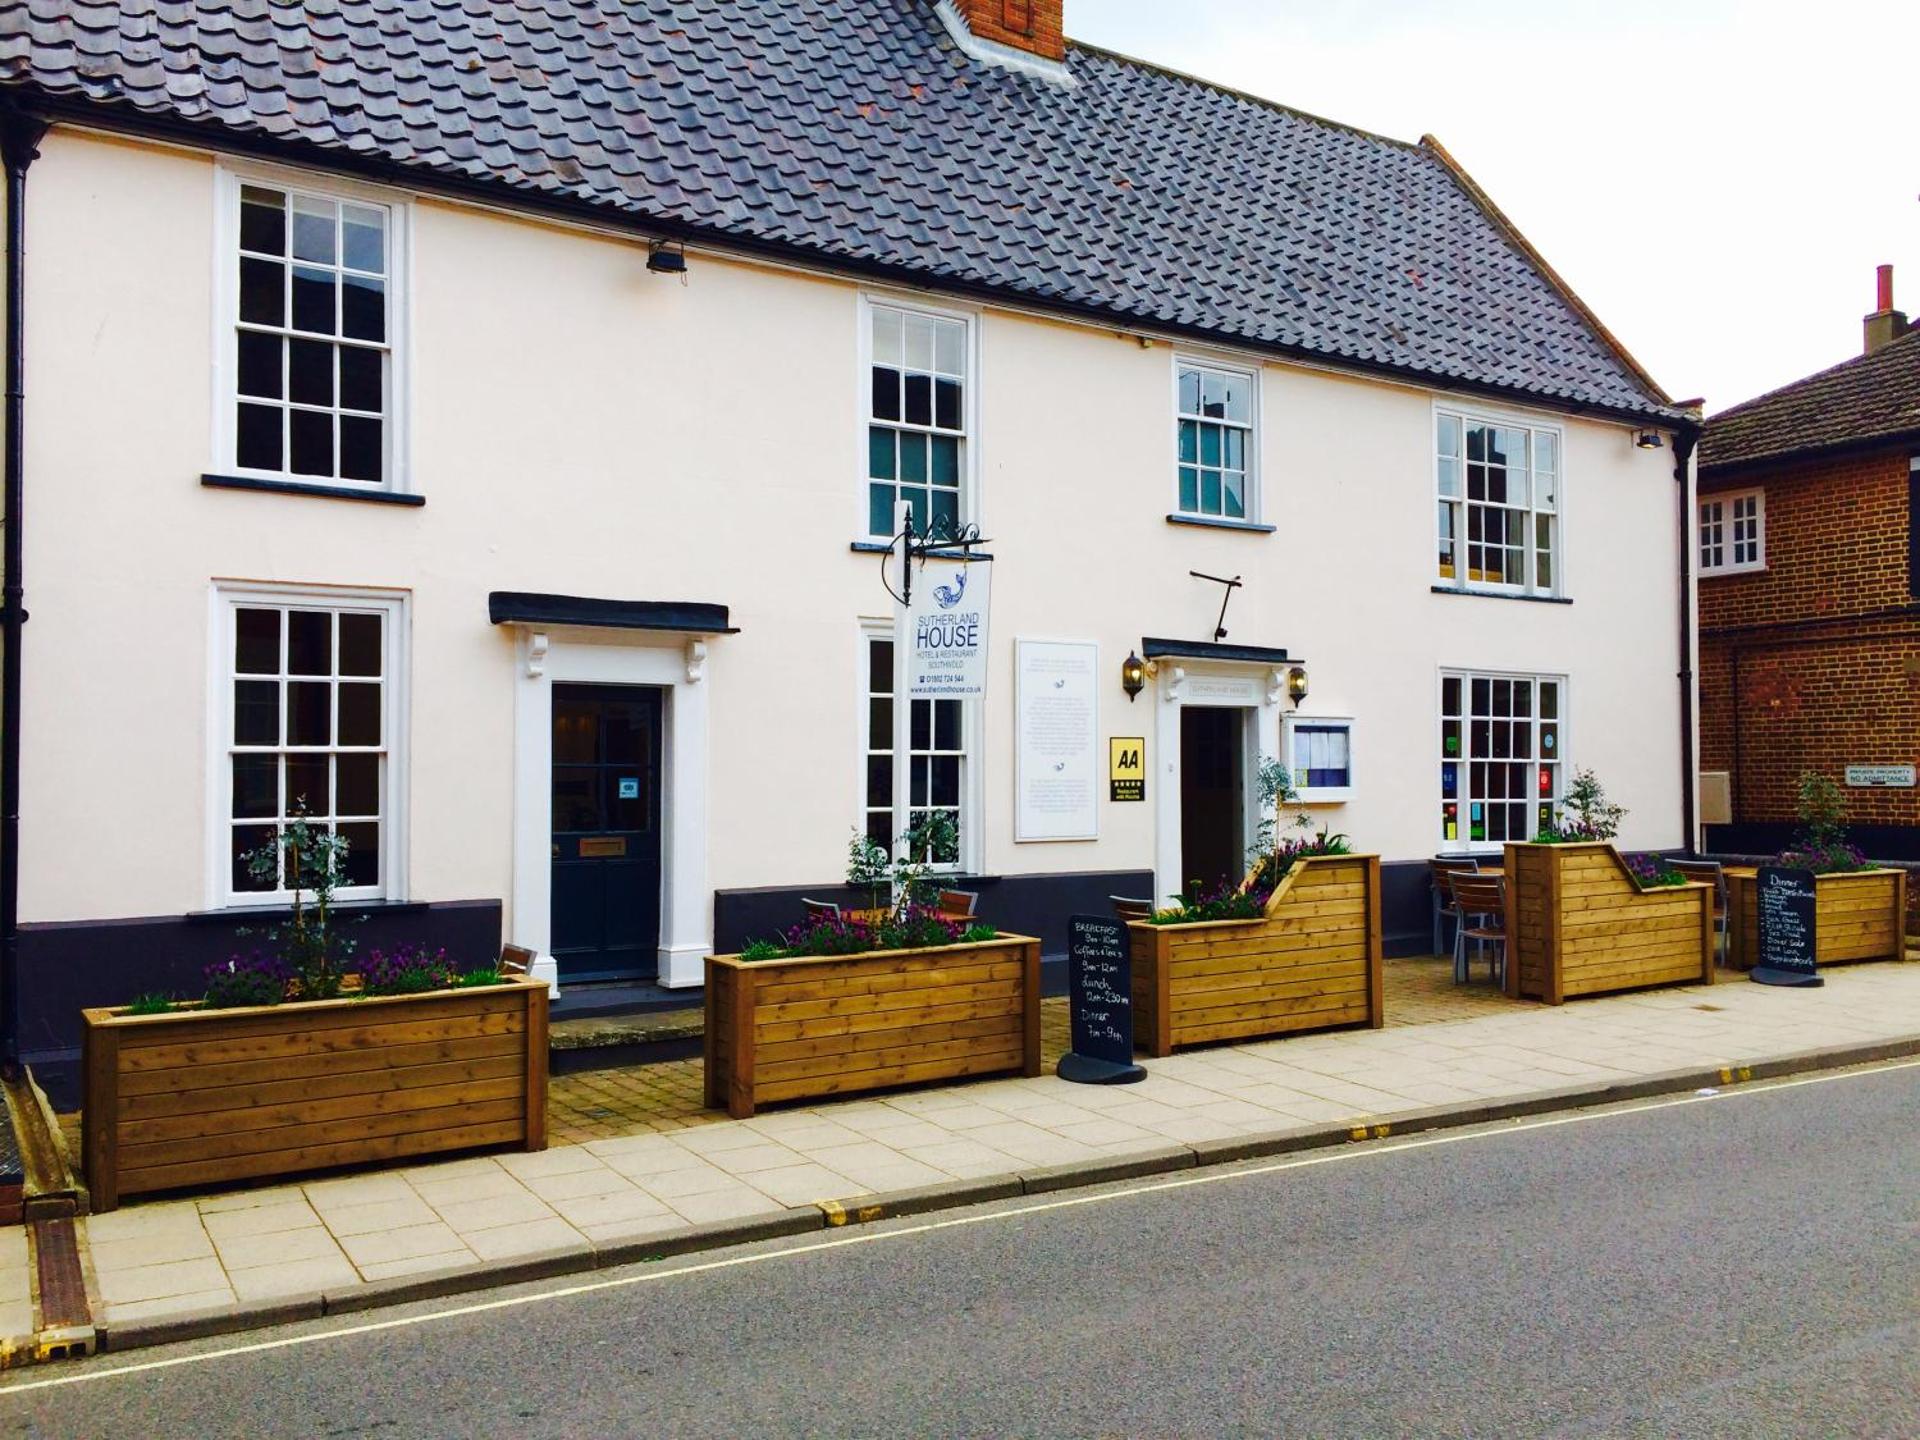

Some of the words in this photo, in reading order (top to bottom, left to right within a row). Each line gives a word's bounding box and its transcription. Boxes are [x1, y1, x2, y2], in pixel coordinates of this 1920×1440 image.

[919, 613, 979, 626] SUTHERLAND
[917, 625, 978, 648] HOUSE
[917, 650, 934, 659] HOTEL
[940, 649, 977, 658] RESTAURANT
[1117, 749, 1138, 769] AA
[1850, 775, 1861, 783] NO
[1863, 775, 1909, 783] ADMITTANCE
[1770, 874, 1801, 887] Dinner
